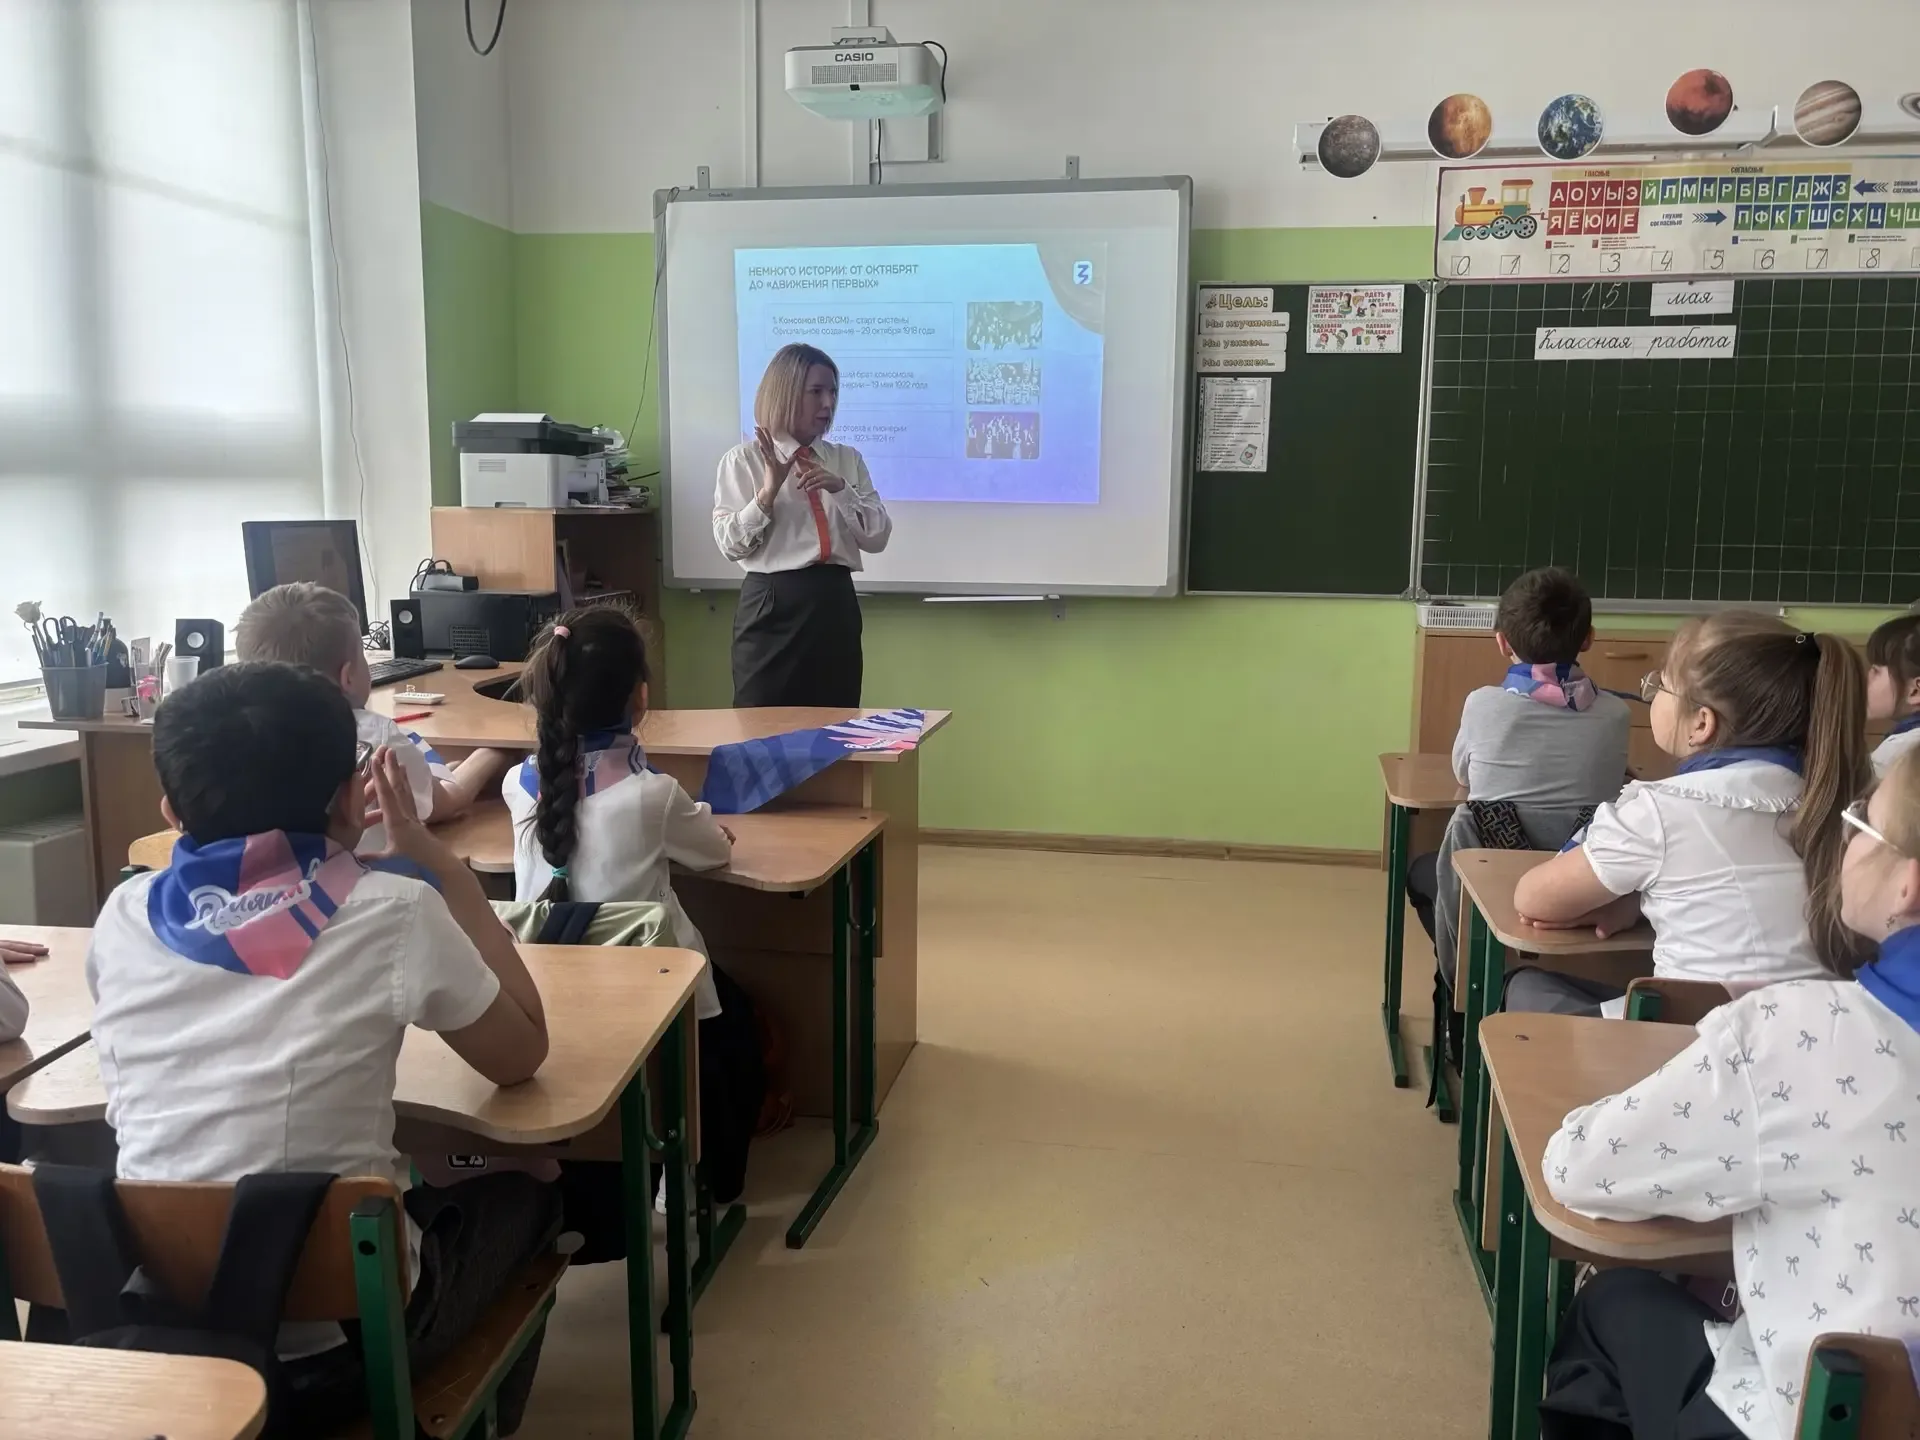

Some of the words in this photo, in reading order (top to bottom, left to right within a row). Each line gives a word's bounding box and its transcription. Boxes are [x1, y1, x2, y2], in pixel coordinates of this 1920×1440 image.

[834, 52, 874, 62] CASIO
[1456, 255, 1471, 276] 0
[1511, 255, 1521, 275] 1
[1557, 253, 1570, 274] 2
[1607, 252, 1621, 273] 3
[1660, 250, 1673, 271] 4
[1710, 249, 1725, 270] 5
[1760, 249, 1775, 270] 6
[1815, 248, 1828, 269] 7
[1865, 248, 1881, 269] 8
[749, 266, 796, 277] НЕМНОГО
[799, 265, 848, 276] ИСТОРИИ:
[850, 265, 864, 275] ОТ
[865, 264, 919, 275] ОКТЯБРЯТ
[749, 280, 764, 291] ДО
[766, 279, 829, 290] «ДВИЖЕНИЯ
[831, 278, 879, 289] ПЕРВЫХ»
[1218, 293, 1269, 310] Цель:
[1667, 291, 1714, 305] мая
[778, 316, 816, 325] Комсомол
[817, 315, 850, 325] (ВЛКСМ)
[855, 317, 875, 325] старт
[877, 316, 910, 325] системы
[1205, 319, 1224, 329] Мы
[871, 326, 901, 336] октября
[918, 327, 936, 336] года
[1202, 338, 1221, 348] Мы
[1538, 328, 1633, 350] Классная
[1646, 326, 1732, 357] работа
[1202, 357, 1221, 368] Мы
